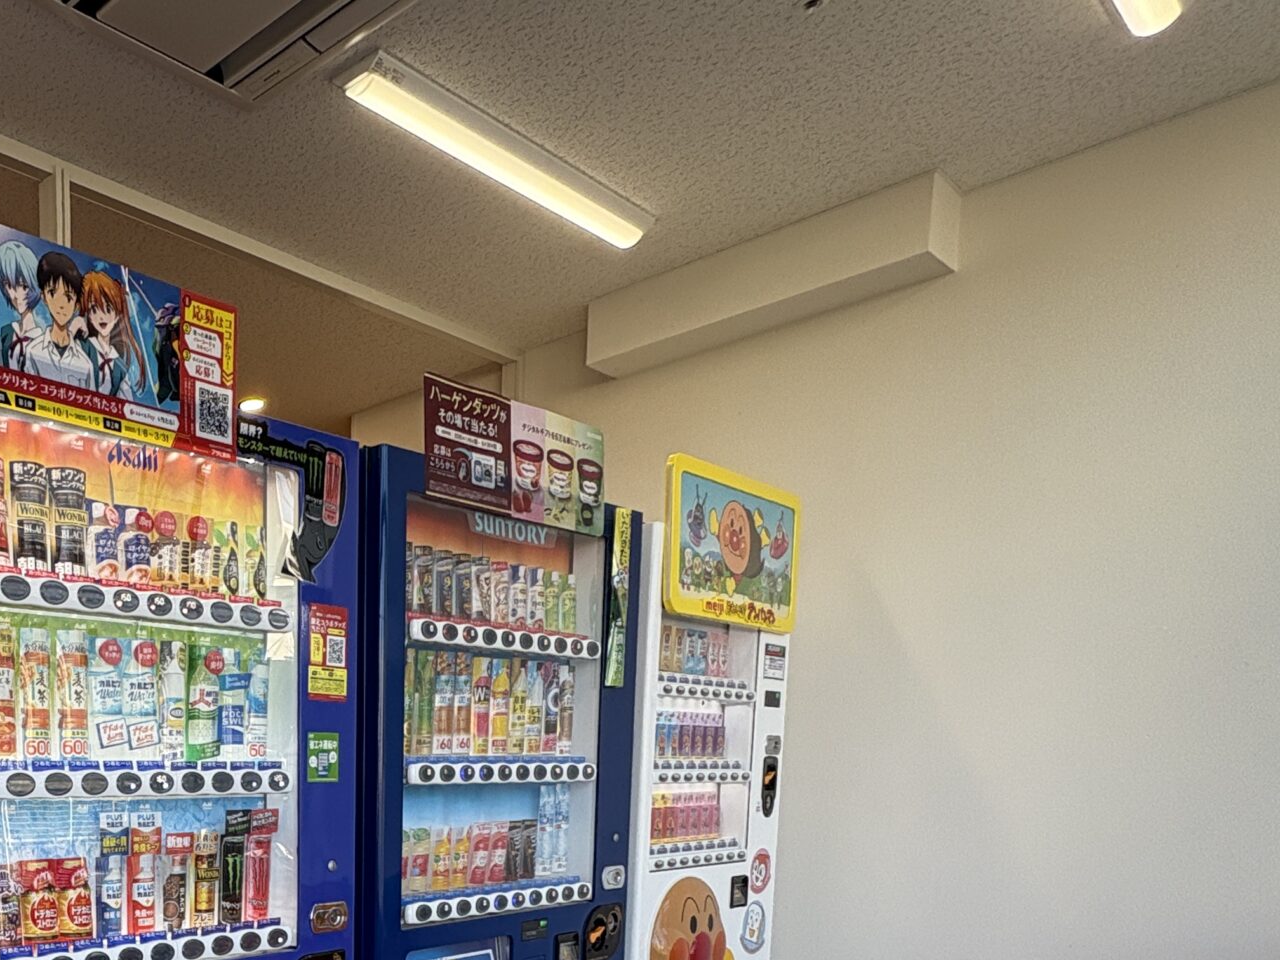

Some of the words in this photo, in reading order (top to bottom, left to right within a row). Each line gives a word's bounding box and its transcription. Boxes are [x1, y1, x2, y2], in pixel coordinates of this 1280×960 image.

[192, 305, 224, 329] 応募は
[429, 385, 508, 424] ハーゲンダッツが
[438, 407, 498, 438] その場で当たる!
[107, 438, 160, 474] Asahi
[55, 509, 86, 523] WONDA
[474, 513, 549, 545] SUNTORY
[36, 670, 48, 707] 麦茶
[72, 671, 85, 707] 麦茶
[137, 813, 155, 821] PLUS
